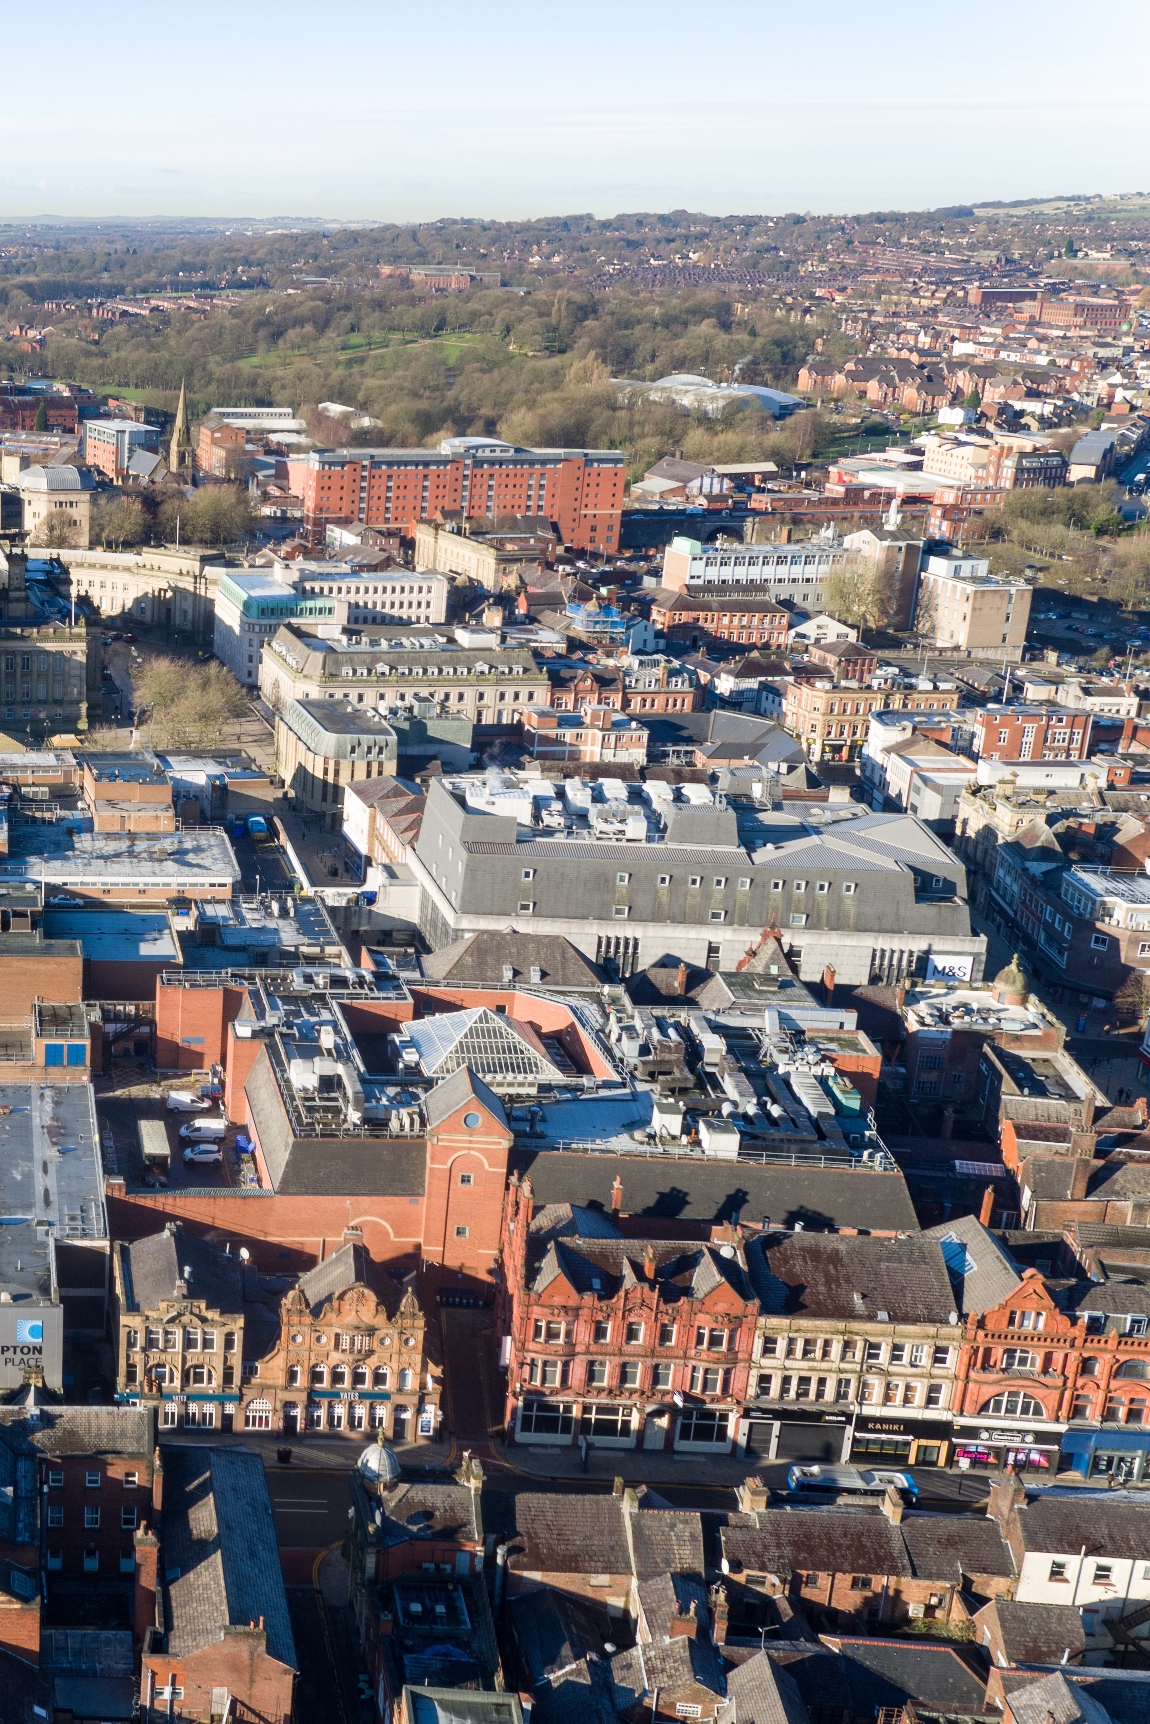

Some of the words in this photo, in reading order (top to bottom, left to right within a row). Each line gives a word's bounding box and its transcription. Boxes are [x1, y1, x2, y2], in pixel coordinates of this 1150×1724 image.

[932, 964, 967, 978] M&S
[4, 1357, 43, 1367] PLACE
[340, 1391, 359, 1400] YATES
